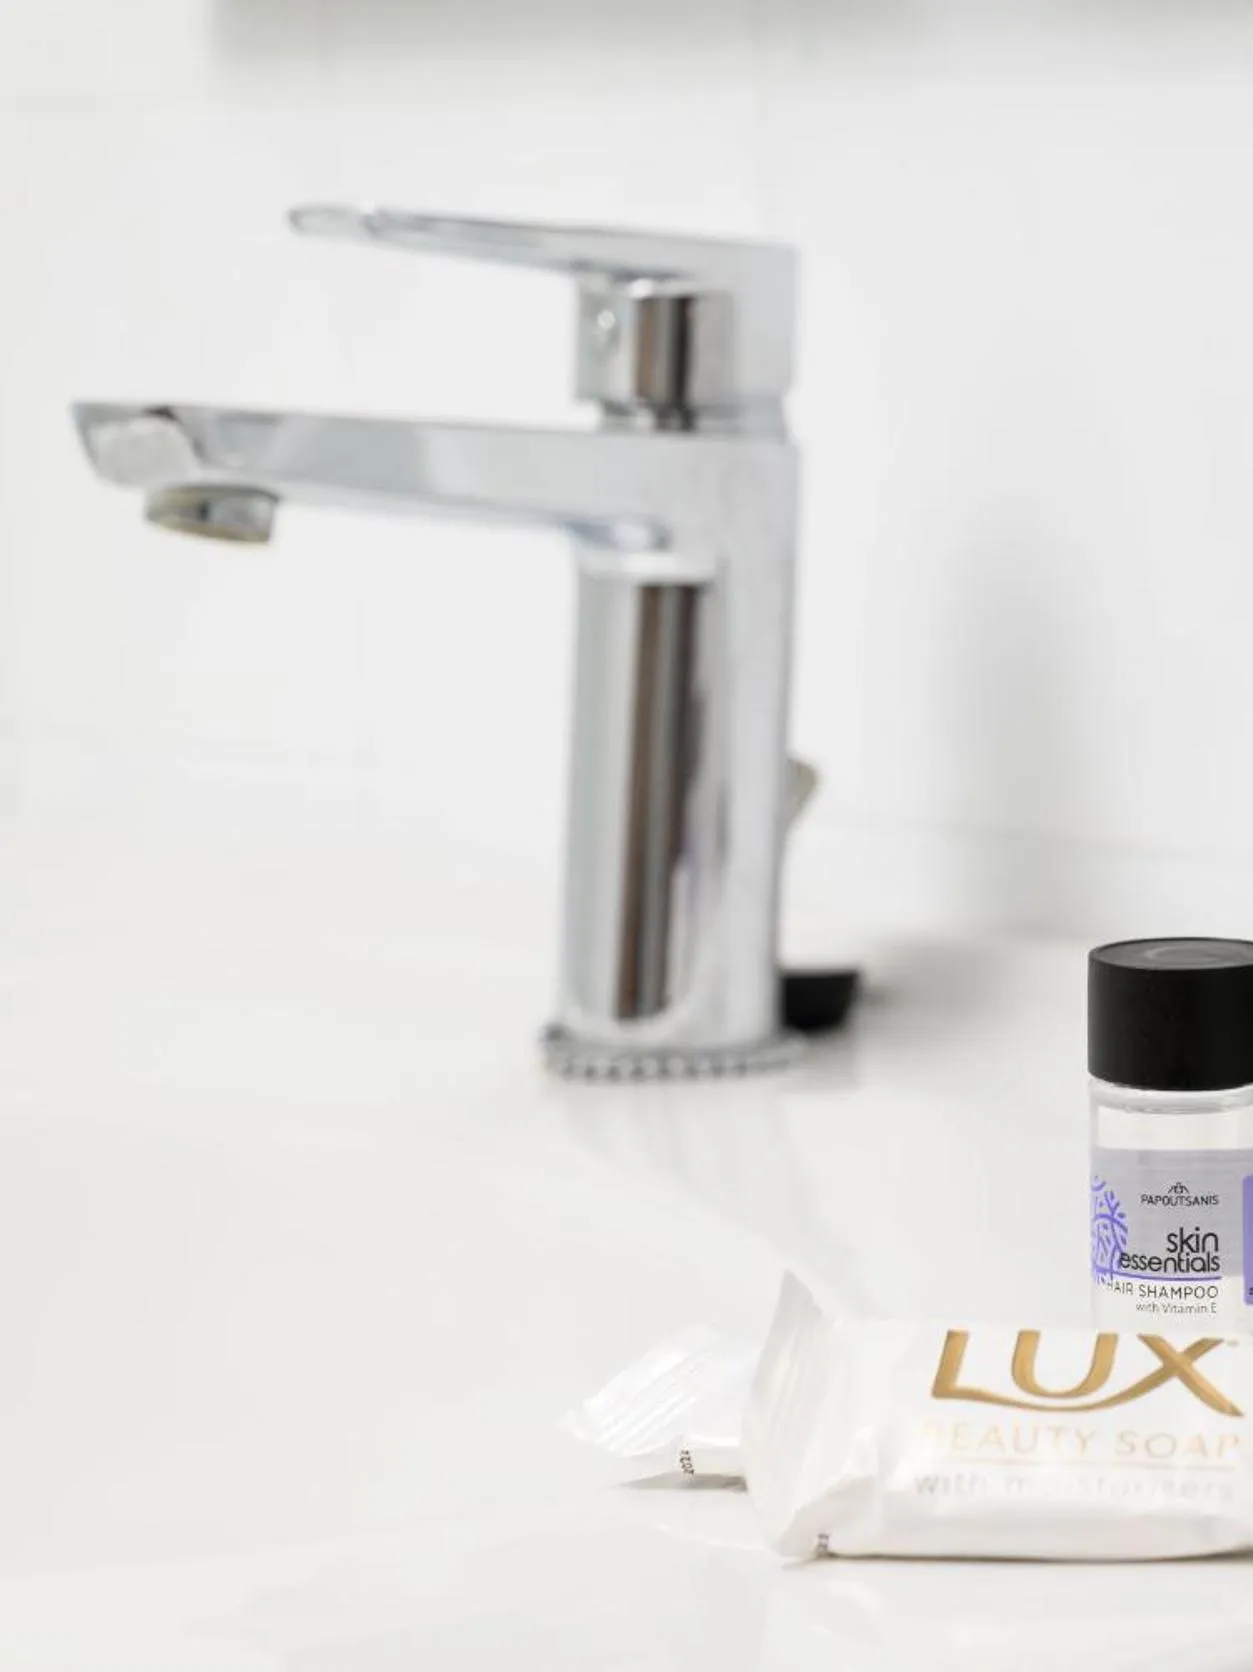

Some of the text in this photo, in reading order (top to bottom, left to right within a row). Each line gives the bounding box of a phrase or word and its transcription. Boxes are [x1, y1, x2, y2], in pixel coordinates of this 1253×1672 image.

[1140, 1193, 1219, 1207] PAPOUTSANIS
[1166, 1226, 1219, 1253] skin
[1118, 1252, 1221, 1273] essentials
[1107, 1280, 1219, 1299] HAIR SHAMPOO
[1136, 1302, 1217, 1314] with Vitamin E
[931, 1329, 1244, 1418] LUX
[1113, 1430, 1242, 1460] SOAP
[914, 1471, 987, 1498] with
